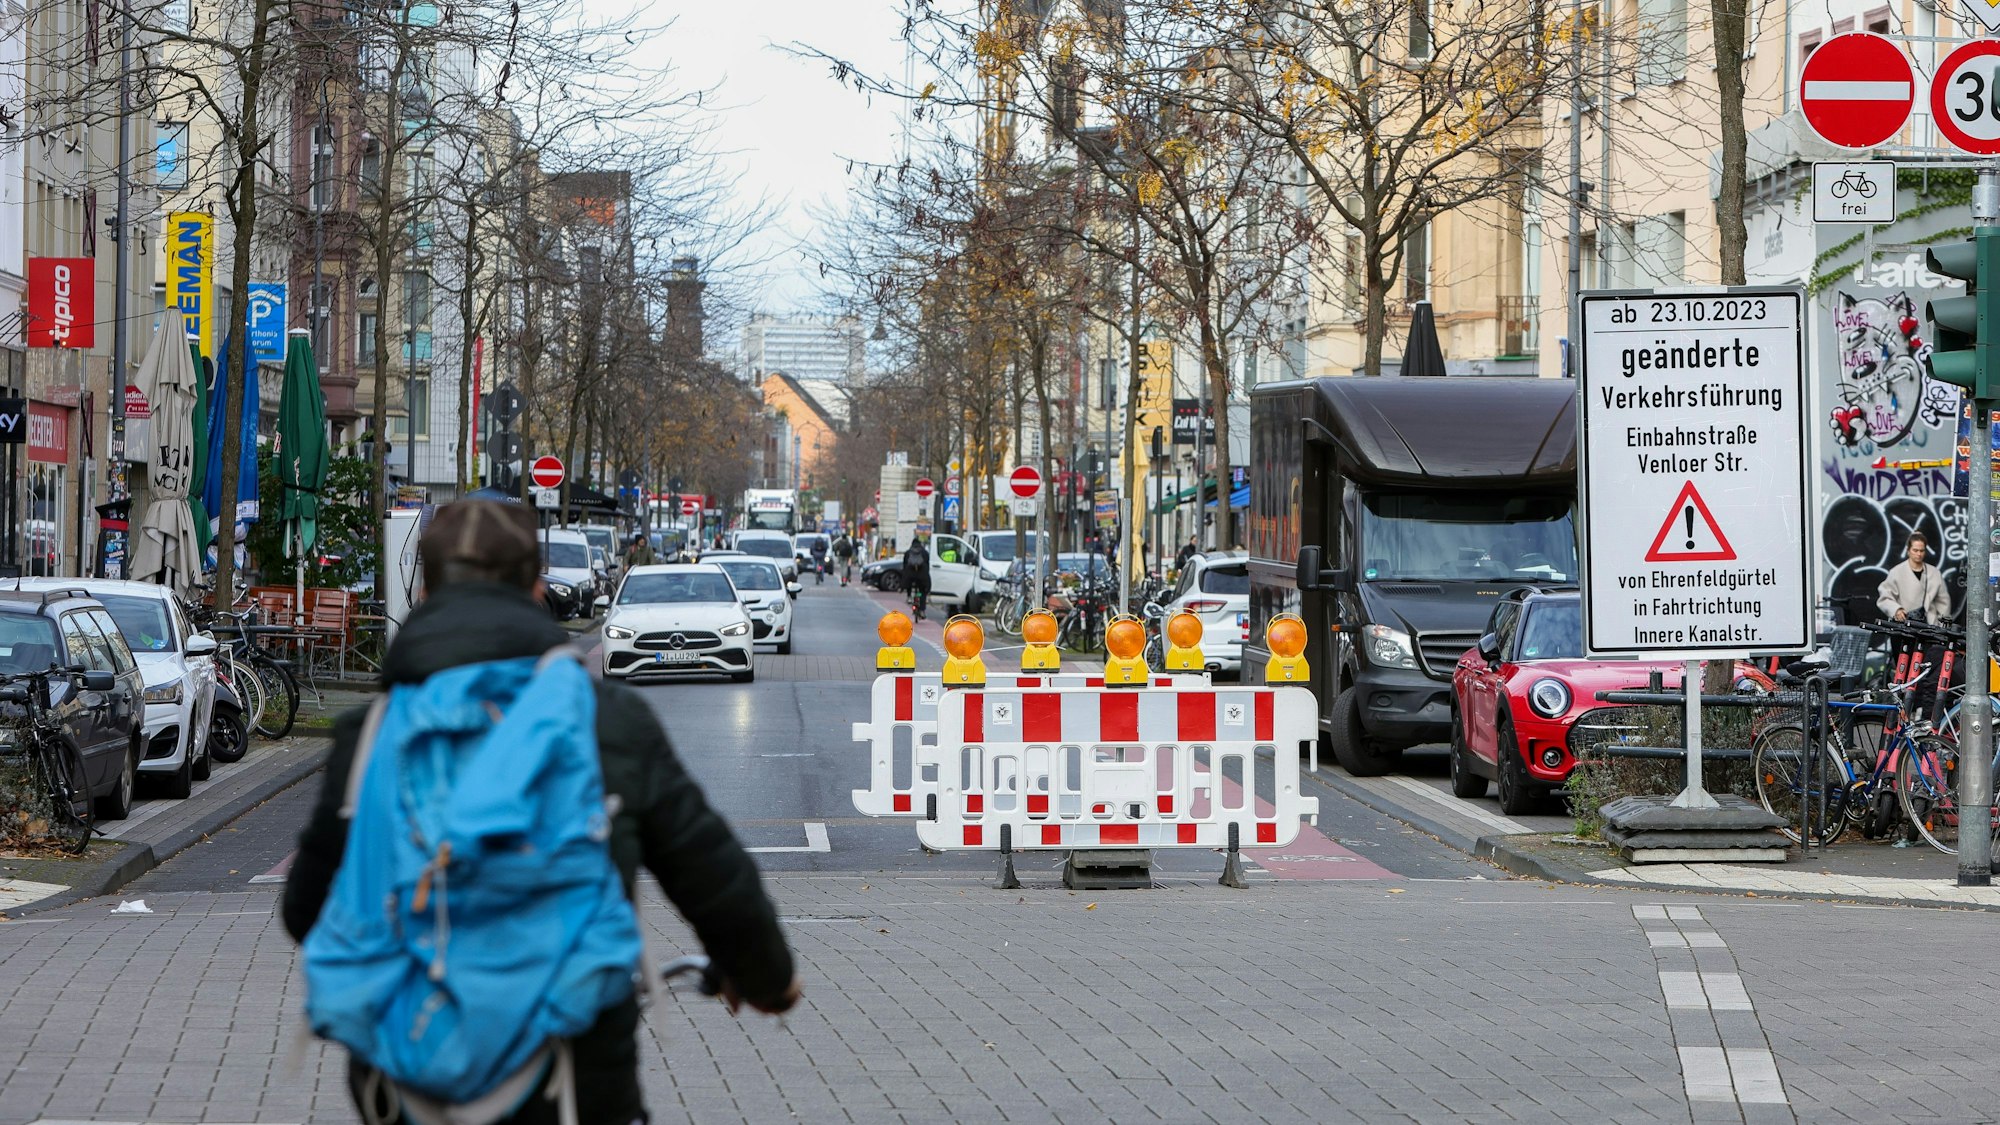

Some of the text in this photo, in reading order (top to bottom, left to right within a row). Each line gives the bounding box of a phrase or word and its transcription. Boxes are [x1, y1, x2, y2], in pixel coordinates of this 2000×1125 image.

[1955, 71, 2000, 122] 3
[1842, 203, 1867, 215] frei
[49, 264, 75, 342] tipico
[1611, 300, 1766, 323] ab 23.10.2023
[1622, 338, 1760, 378] geänderte
[1602, 384, 1782, 412] Verkehrsführung
[1627, 425, 1758, 447] Einbahnstraße
[1638, 451, 1748, 474] Venloer Str.
[1618, 568, 1777, 591] von Ehrenfeldgürtel
[1634, 597, 1761, 618] in Fahrtrichtung
[1635, 624, 1762, 643] Innere Kanalstr.
